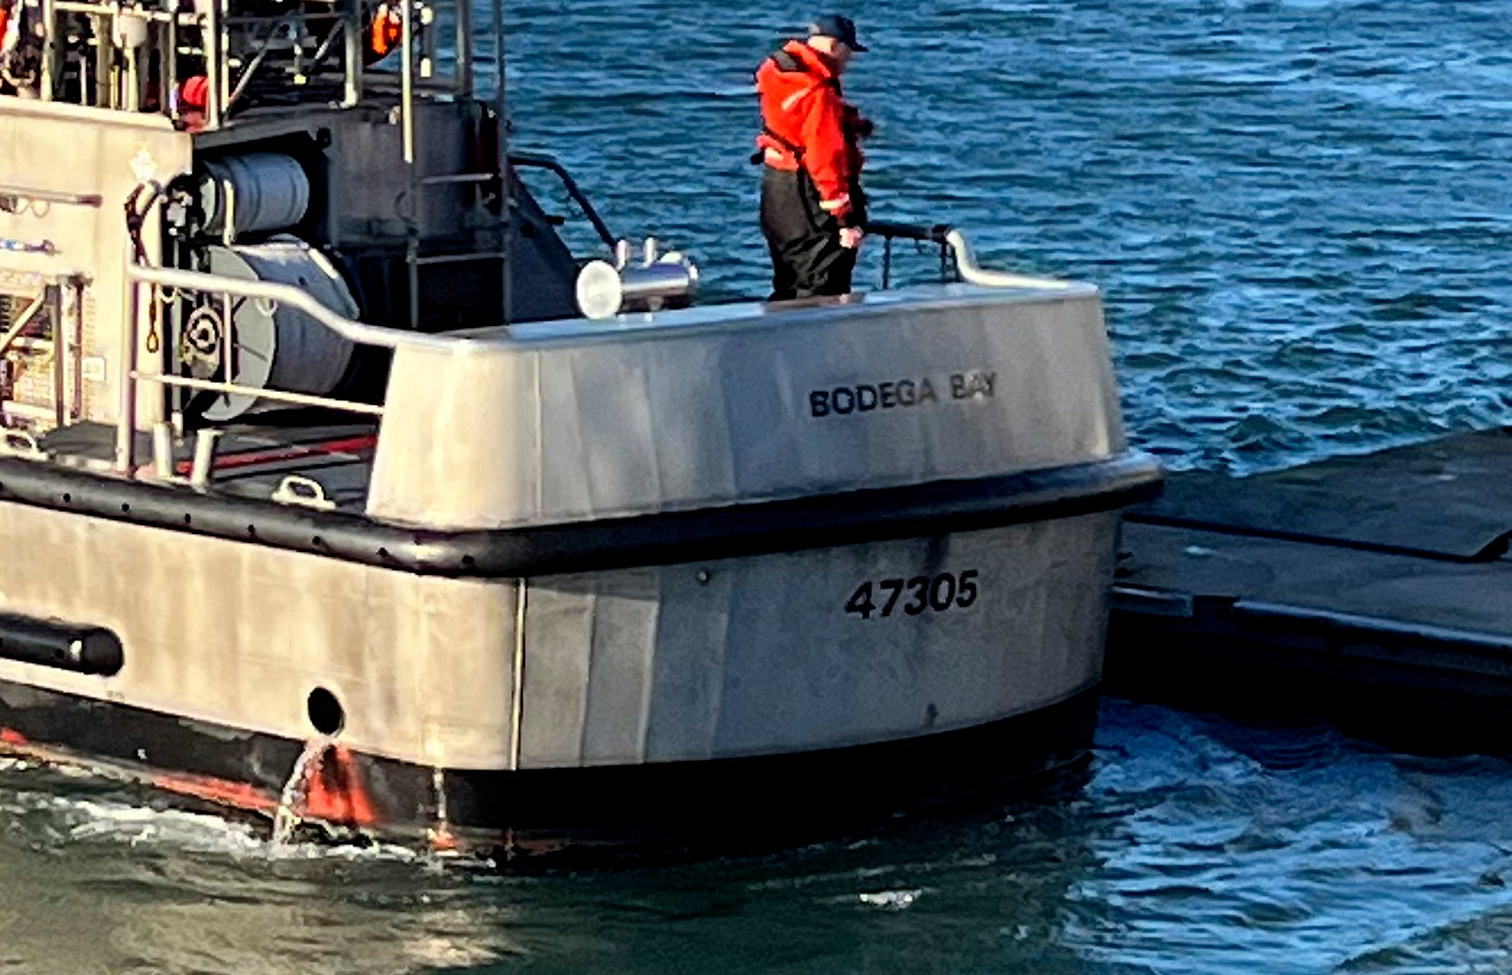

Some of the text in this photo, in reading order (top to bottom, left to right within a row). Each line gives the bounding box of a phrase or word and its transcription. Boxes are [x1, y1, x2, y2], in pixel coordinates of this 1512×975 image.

[809, 370, 998, 418] BODEGA BAY
[844, 569, 979, 619] 47305
